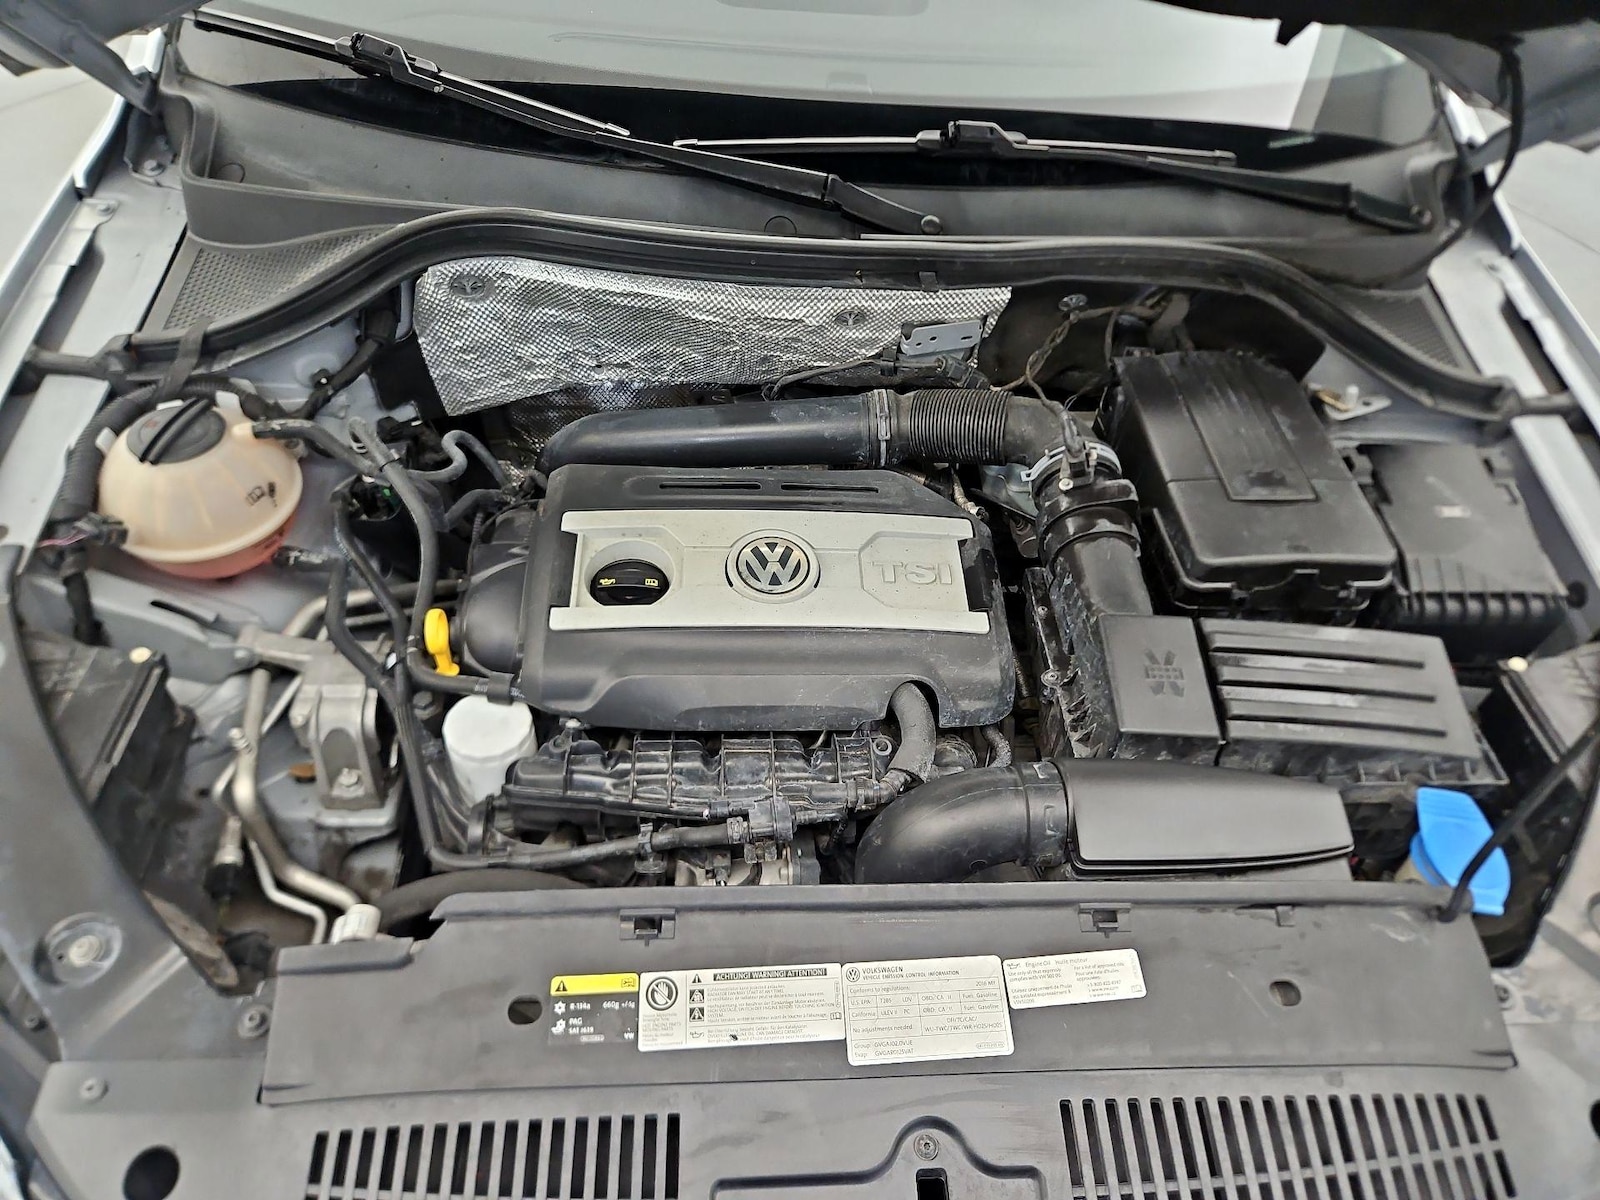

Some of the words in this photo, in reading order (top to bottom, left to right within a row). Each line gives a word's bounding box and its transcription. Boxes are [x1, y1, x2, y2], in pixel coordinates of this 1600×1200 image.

[870, 561, 953, 585] TSI
[716, 972, 751, 981] ACHTUNG!
[752, 970, 787, 979] WARNING!
[787, 968, 826, 977] ATTENTION!
[862, 966, 903, 974] VOLKSWAGEN
[602, 1001, 620, 1010] 660g
[569, 1017, 583, 1025] PAG
